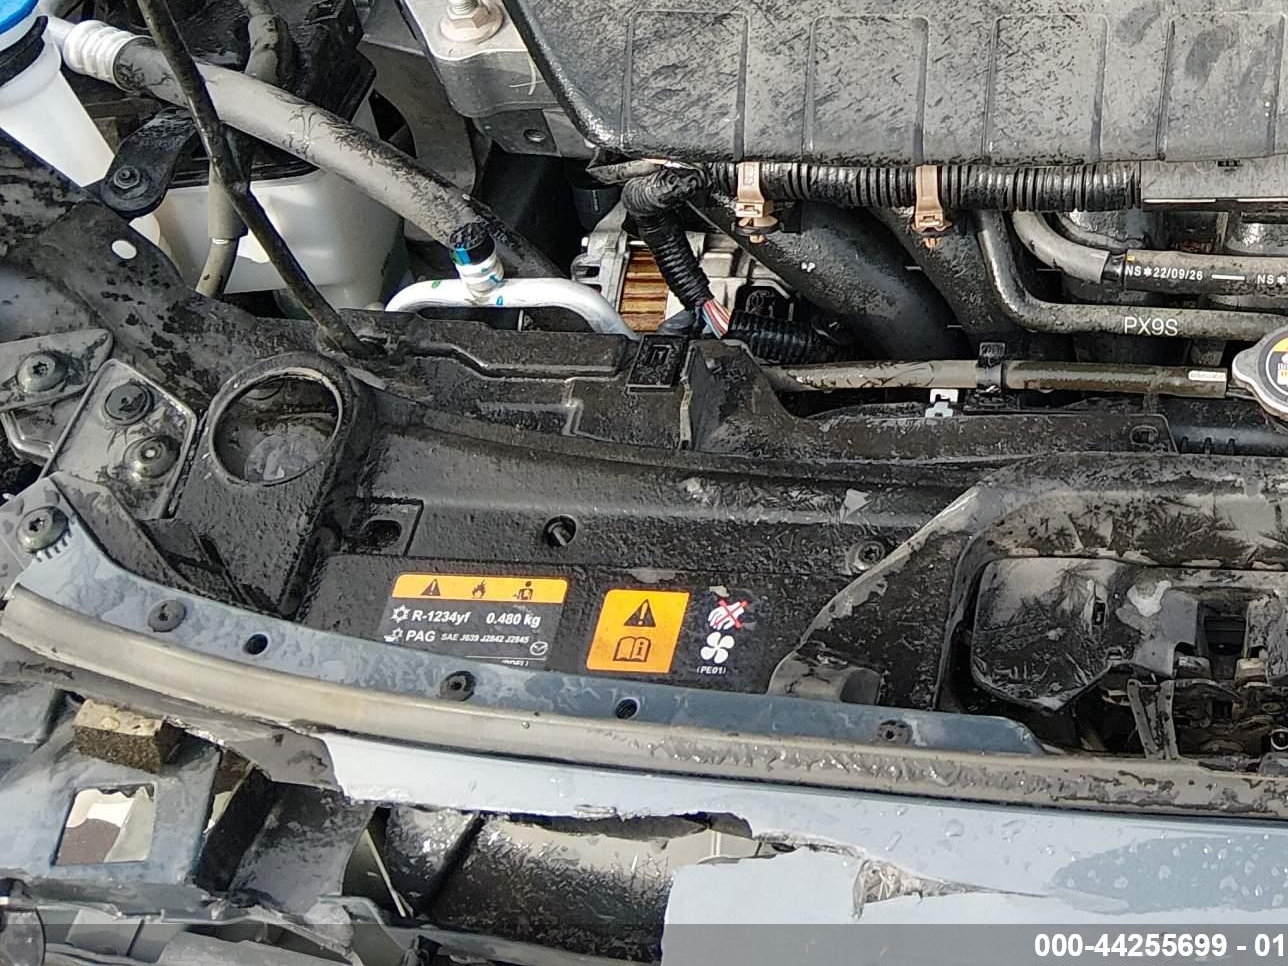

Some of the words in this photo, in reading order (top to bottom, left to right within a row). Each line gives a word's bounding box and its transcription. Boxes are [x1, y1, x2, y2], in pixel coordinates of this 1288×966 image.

[1124, 316, 1178, 337] PX9S
[411, 609, 472, 626] R-1234yf
[485, 612, 522, 625] 0.480
[523, 614, 542, 629] kg
[405, 629, 436, 643] PAG
[440, 633, 459, 642] SAE
[459, 634, 480, 642] J639
[480, 634, 505, 643] J2842
[505, 635, 529, 644] J2845
[696, 665, 727, 675] (PE01)
